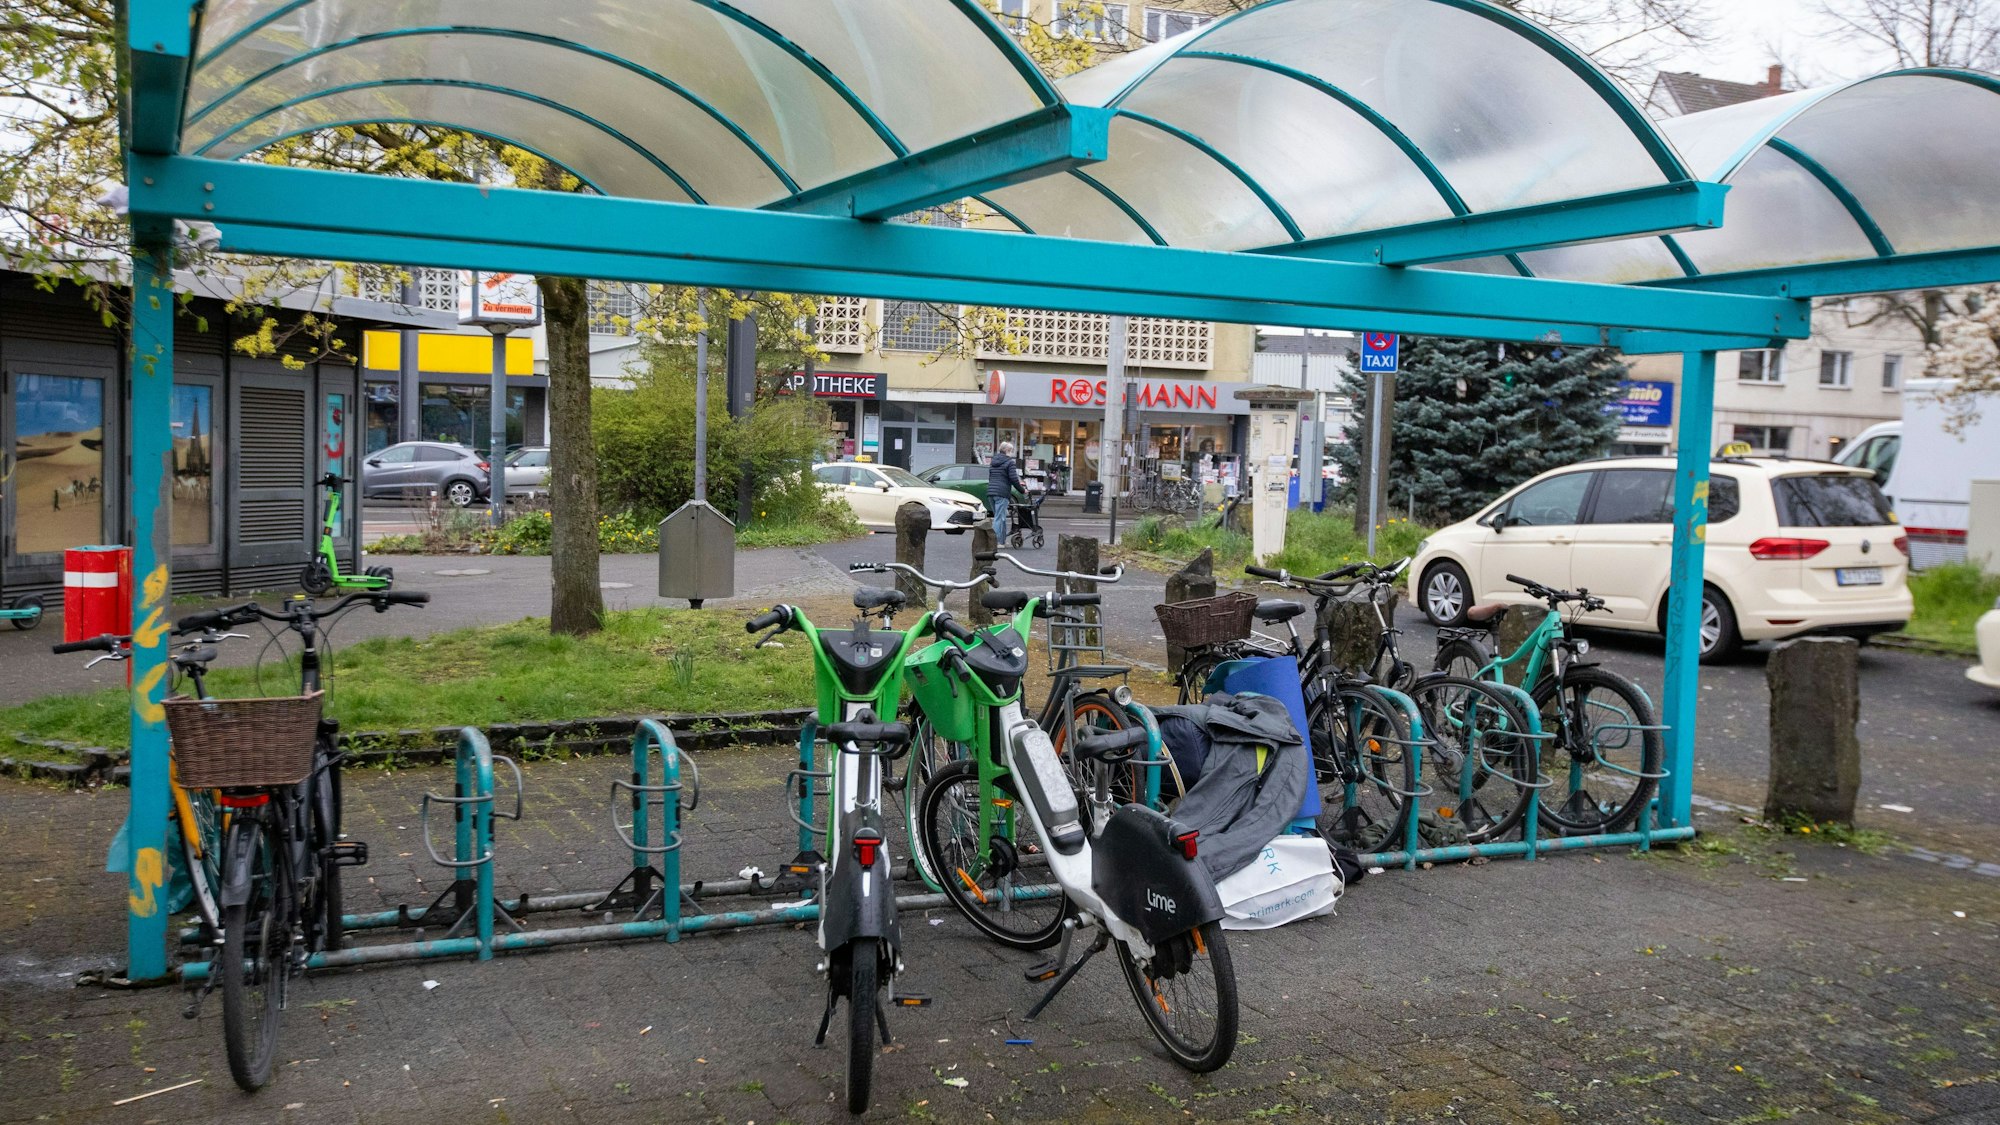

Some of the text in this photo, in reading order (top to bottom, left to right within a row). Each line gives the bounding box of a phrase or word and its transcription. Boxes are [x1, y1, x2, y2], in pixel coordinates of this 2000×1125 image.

[1364, 354, 1394, 368] TAXI
[1050, 378, 1217, 410] ROSMANN
[1145, 888, 1177, 914] Lime
[1248, 888, 1316, 922] primark.com
